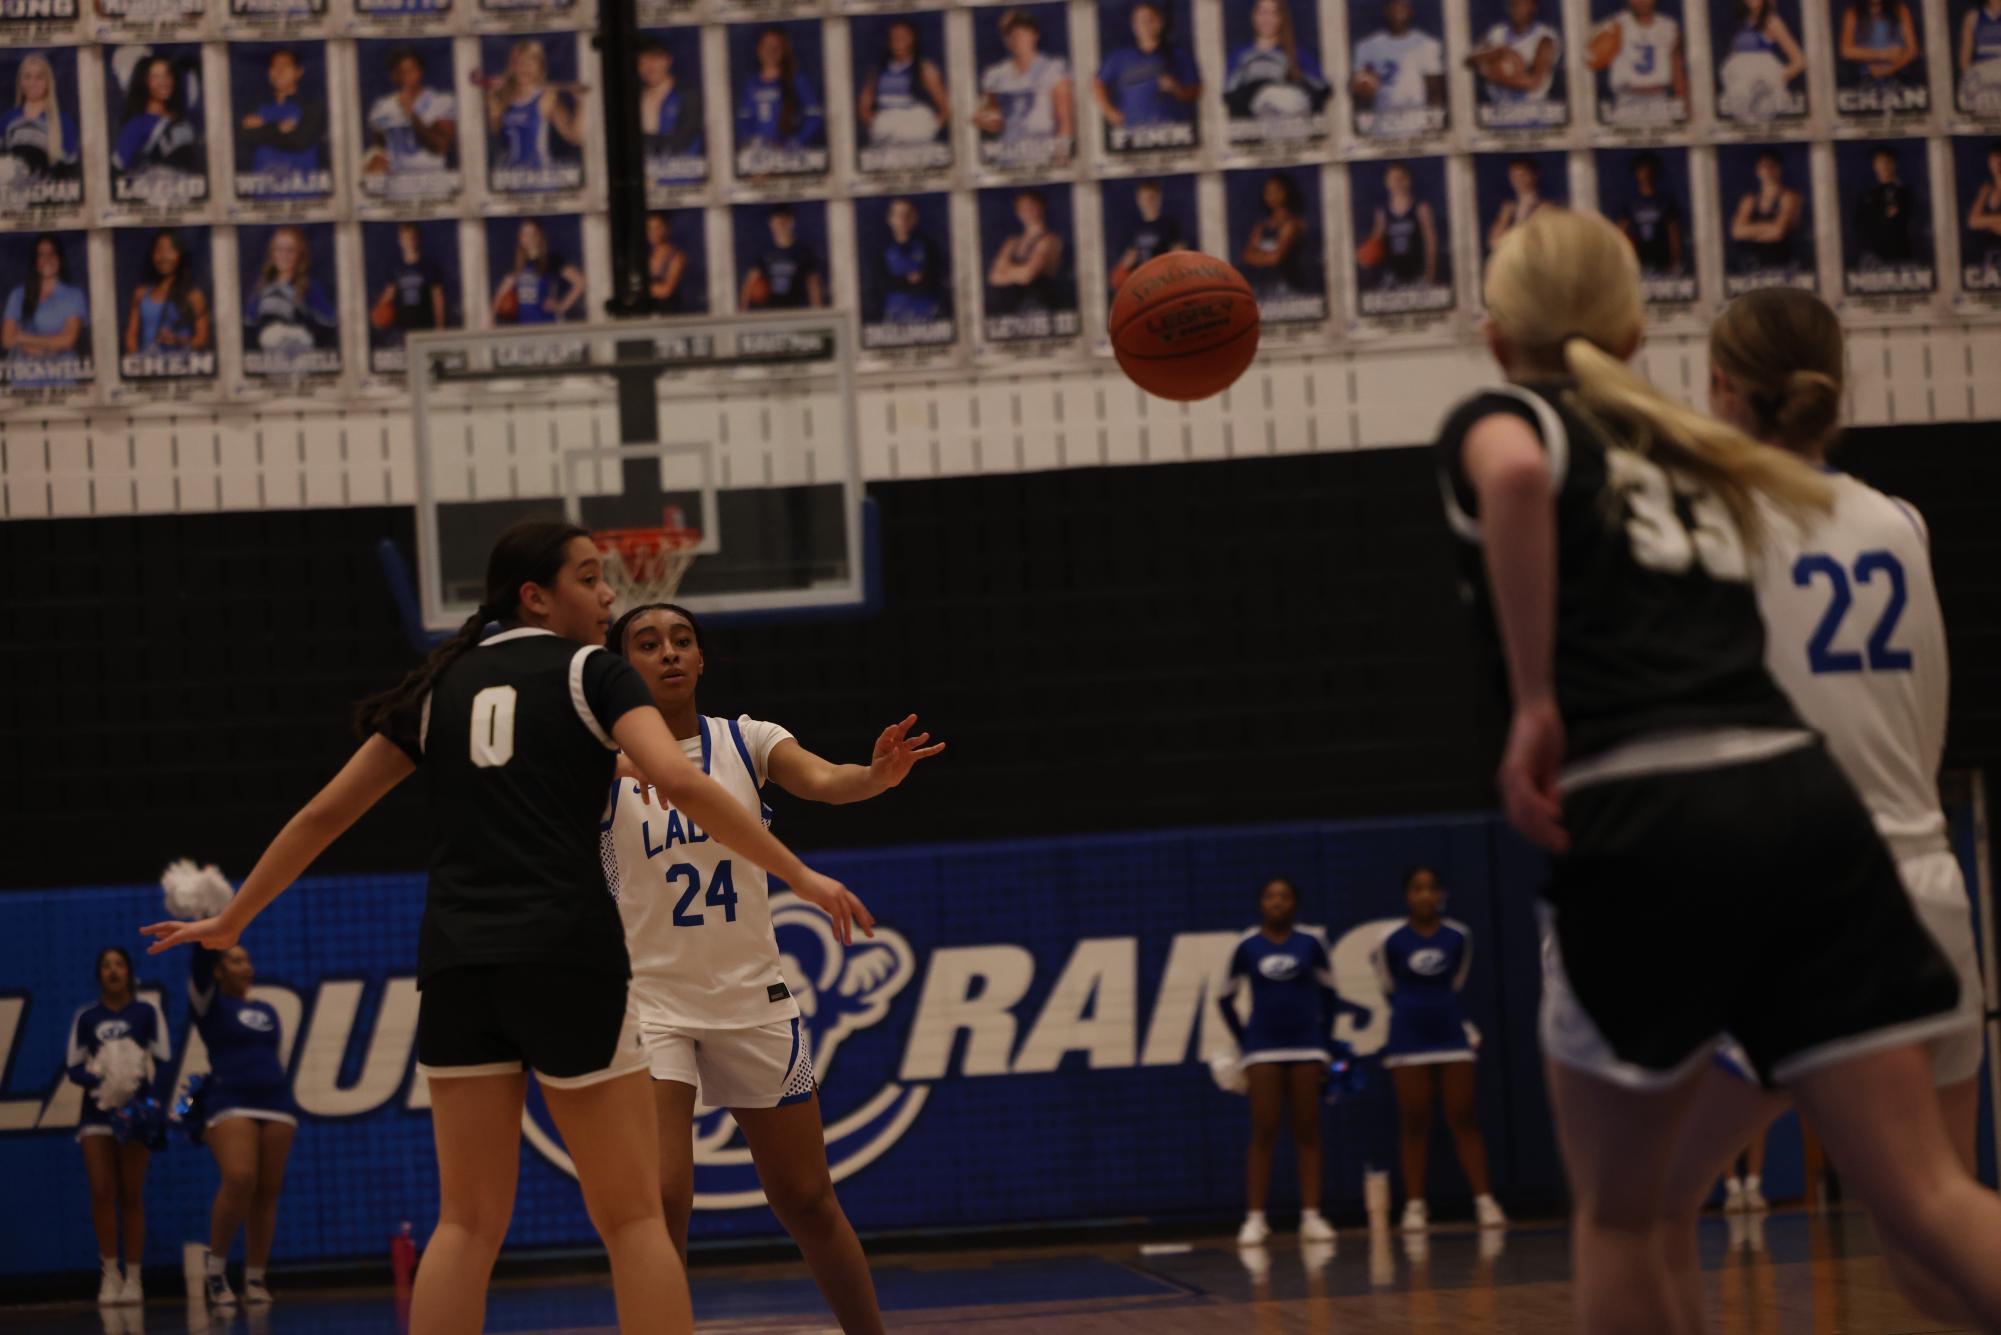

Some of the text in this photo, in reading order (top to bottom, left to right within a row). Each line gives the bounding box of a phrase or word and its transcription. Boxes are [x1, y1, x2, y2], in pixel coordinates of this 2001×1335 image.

[1793, 550, 1911, 673] 22
[470, 684, 518, 768] 0
[666, 859, 738, 927] 24
